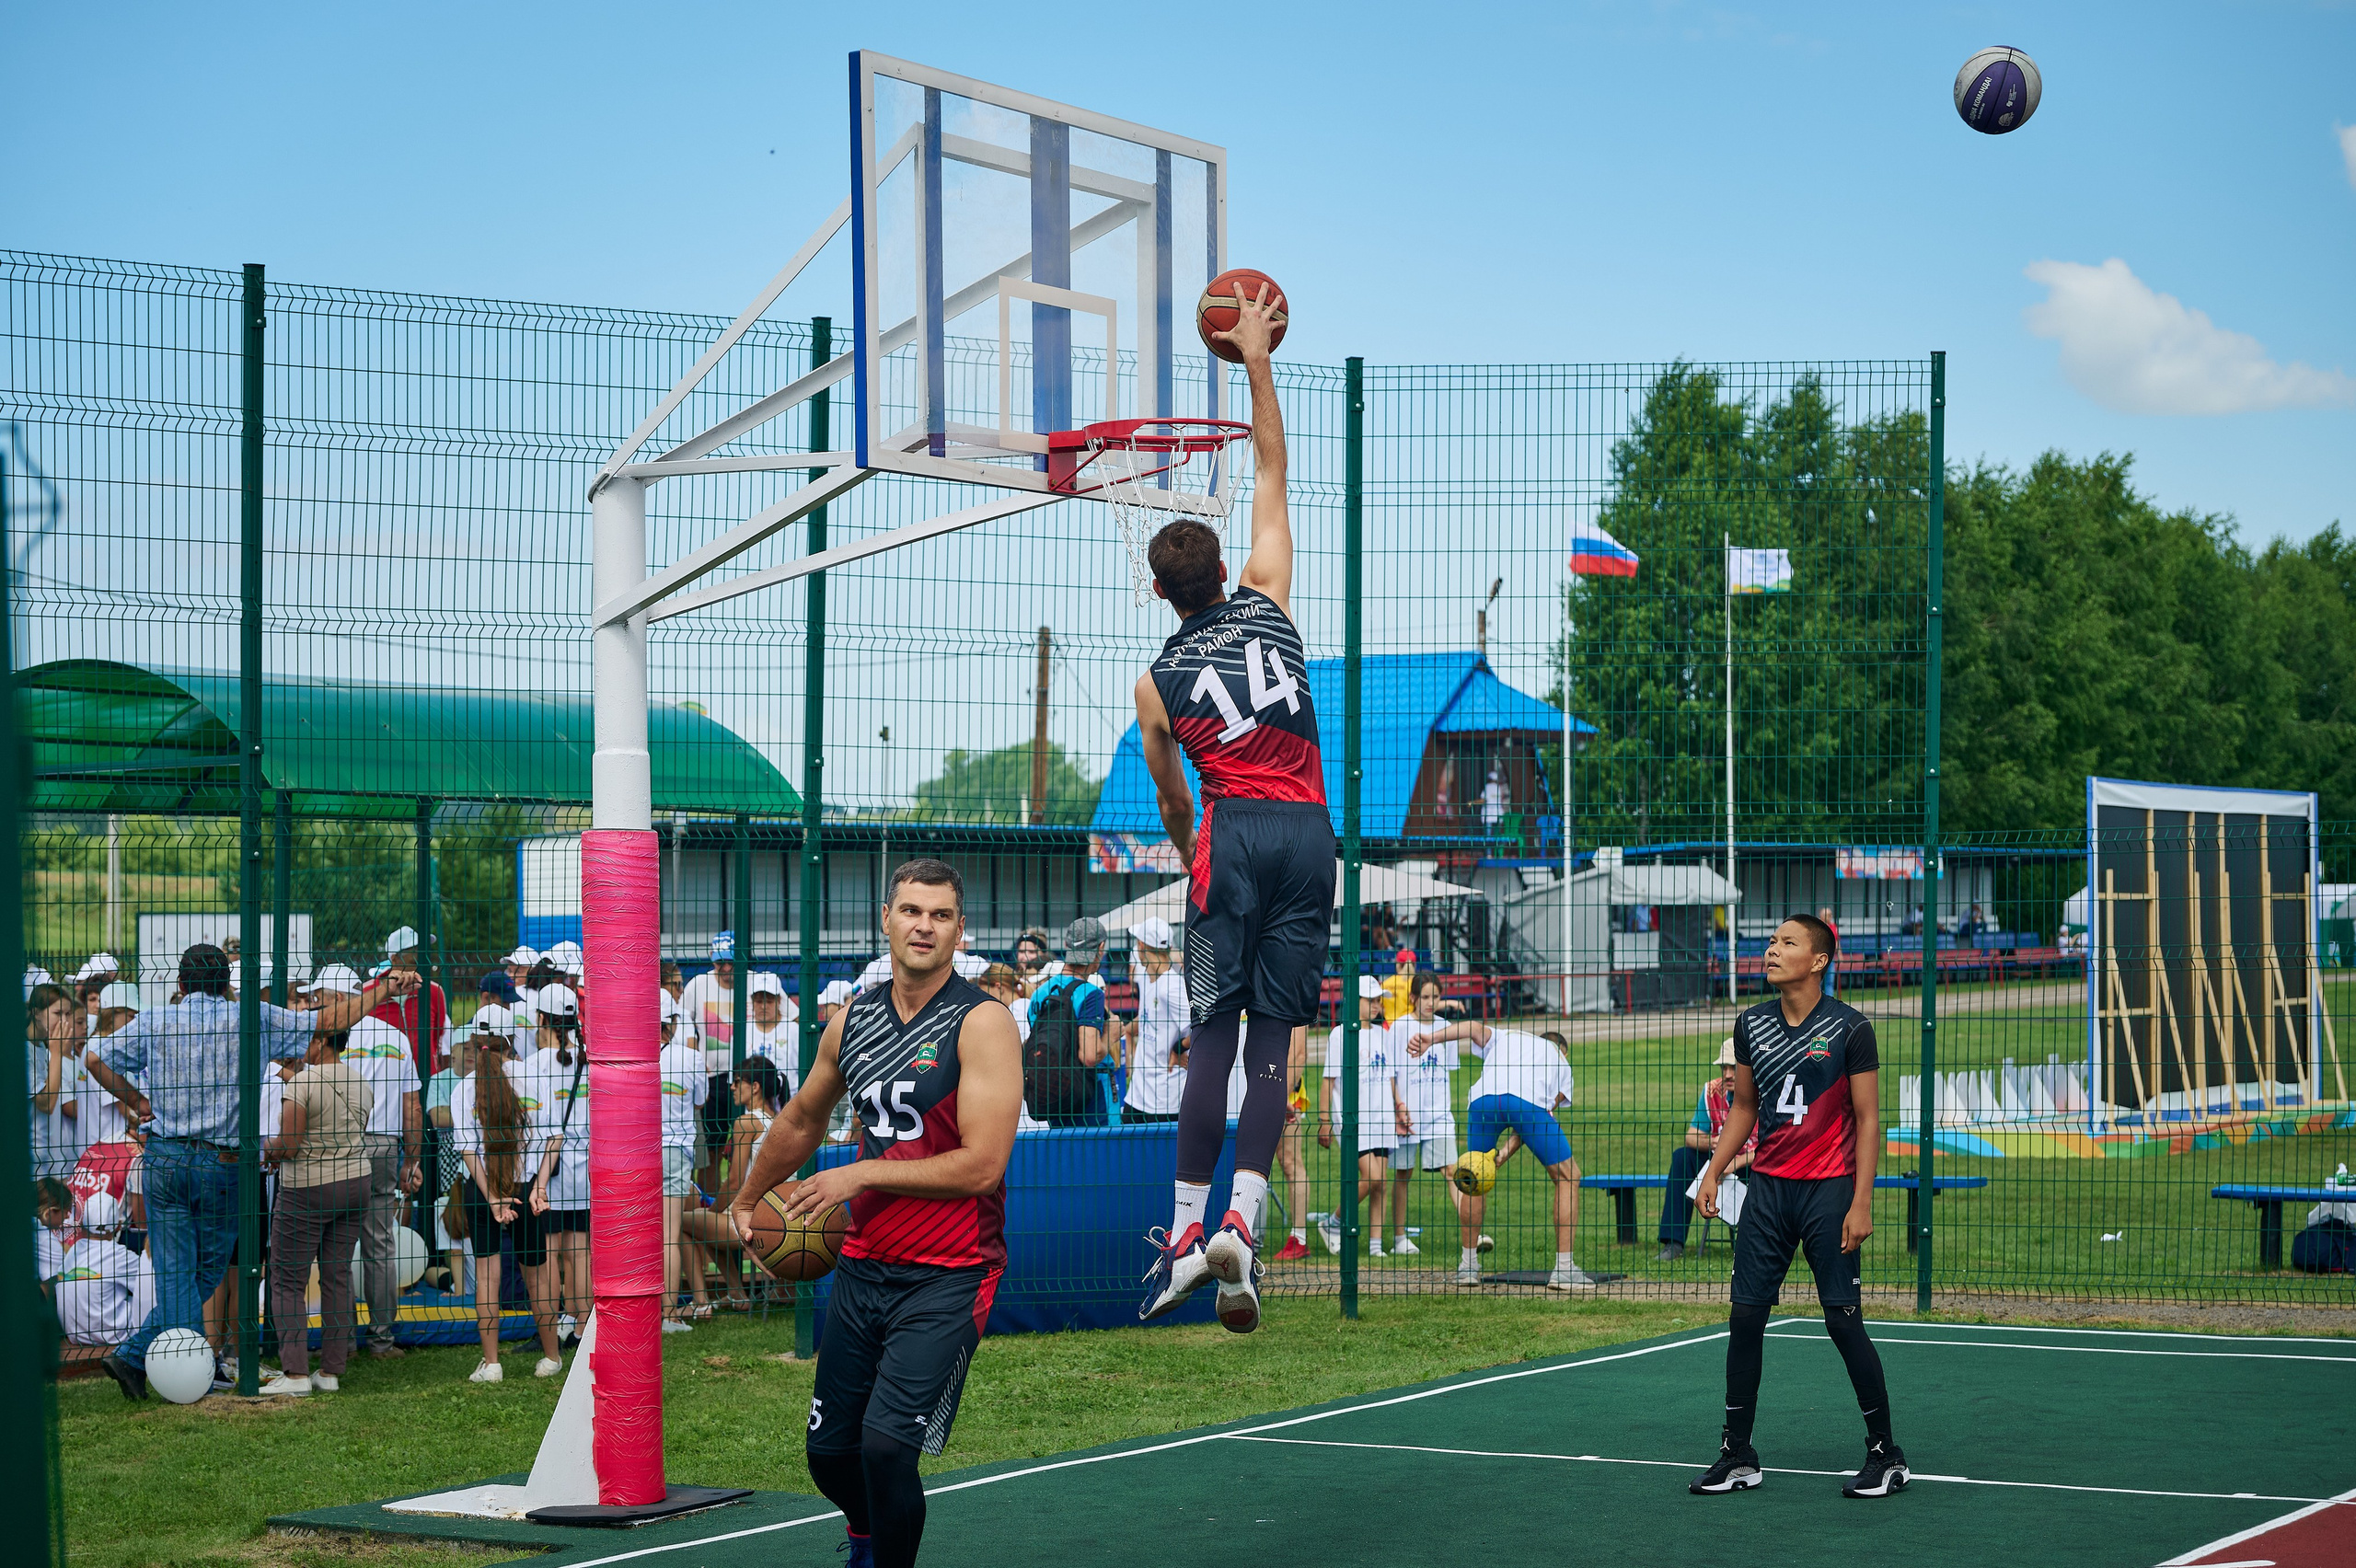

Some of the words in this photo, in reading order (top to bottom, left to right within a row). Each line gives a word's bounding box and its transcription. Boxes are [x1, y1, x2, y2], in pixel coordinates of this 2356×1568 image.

[1973, 76, 1992, 109] КОМАНДА!
[1197, 623, 1243, 659] РАЙОН
[1189, 636, 1301, 746] 14
[856, 1053, 872, 1061] SL
[1758, 1043, 1773, 1052] SL
[860, 1080, 924, 1141] 15
[1775, 1073, 1808, 1126] 4
